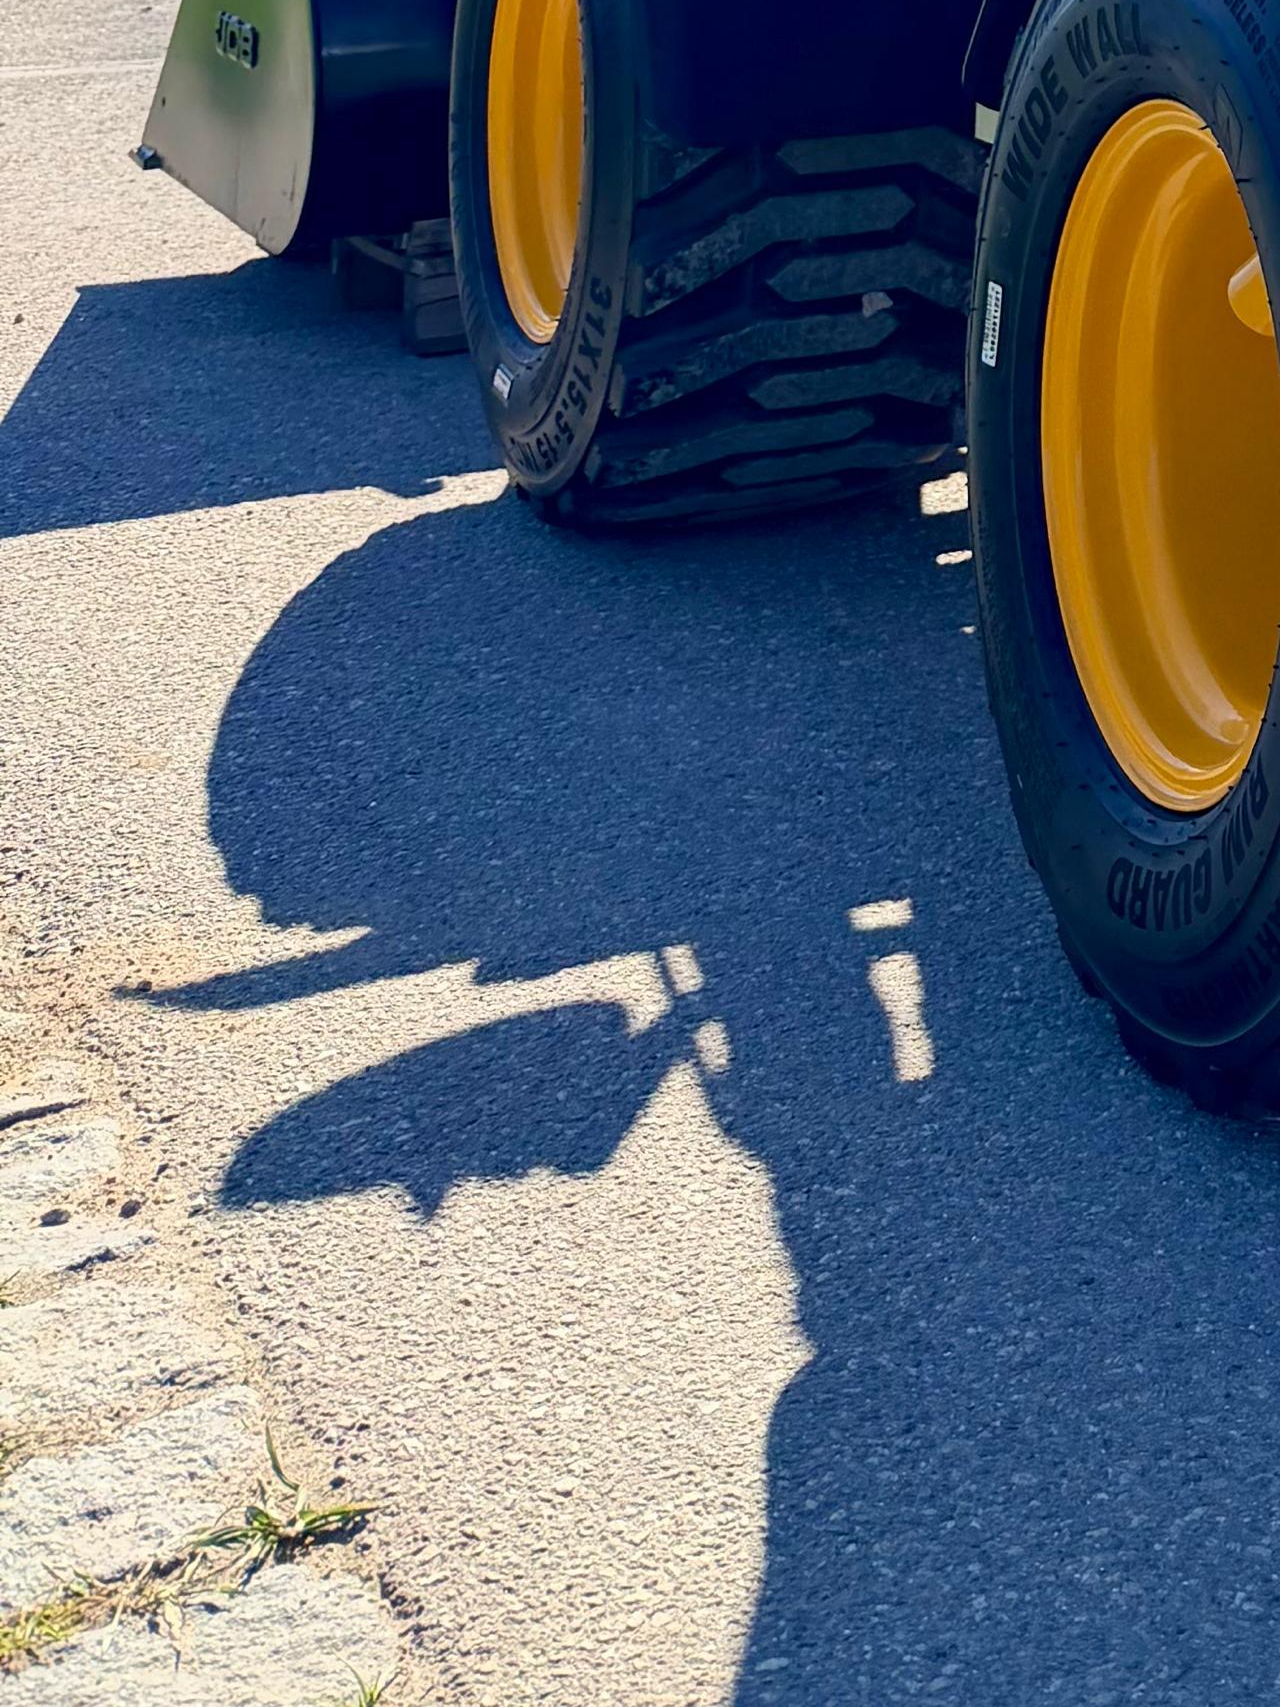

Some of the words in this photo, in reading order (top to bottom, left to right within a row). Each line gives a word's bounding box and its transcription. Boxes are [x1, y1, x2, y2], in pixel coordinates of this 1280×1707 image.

[1001, 54, 1070, 203] WIDE
[1065, 2, 1154, 80] WALL
[1219, 751, 1270, 886] RIM
[1106, 846, 1212, 932] GUARD
